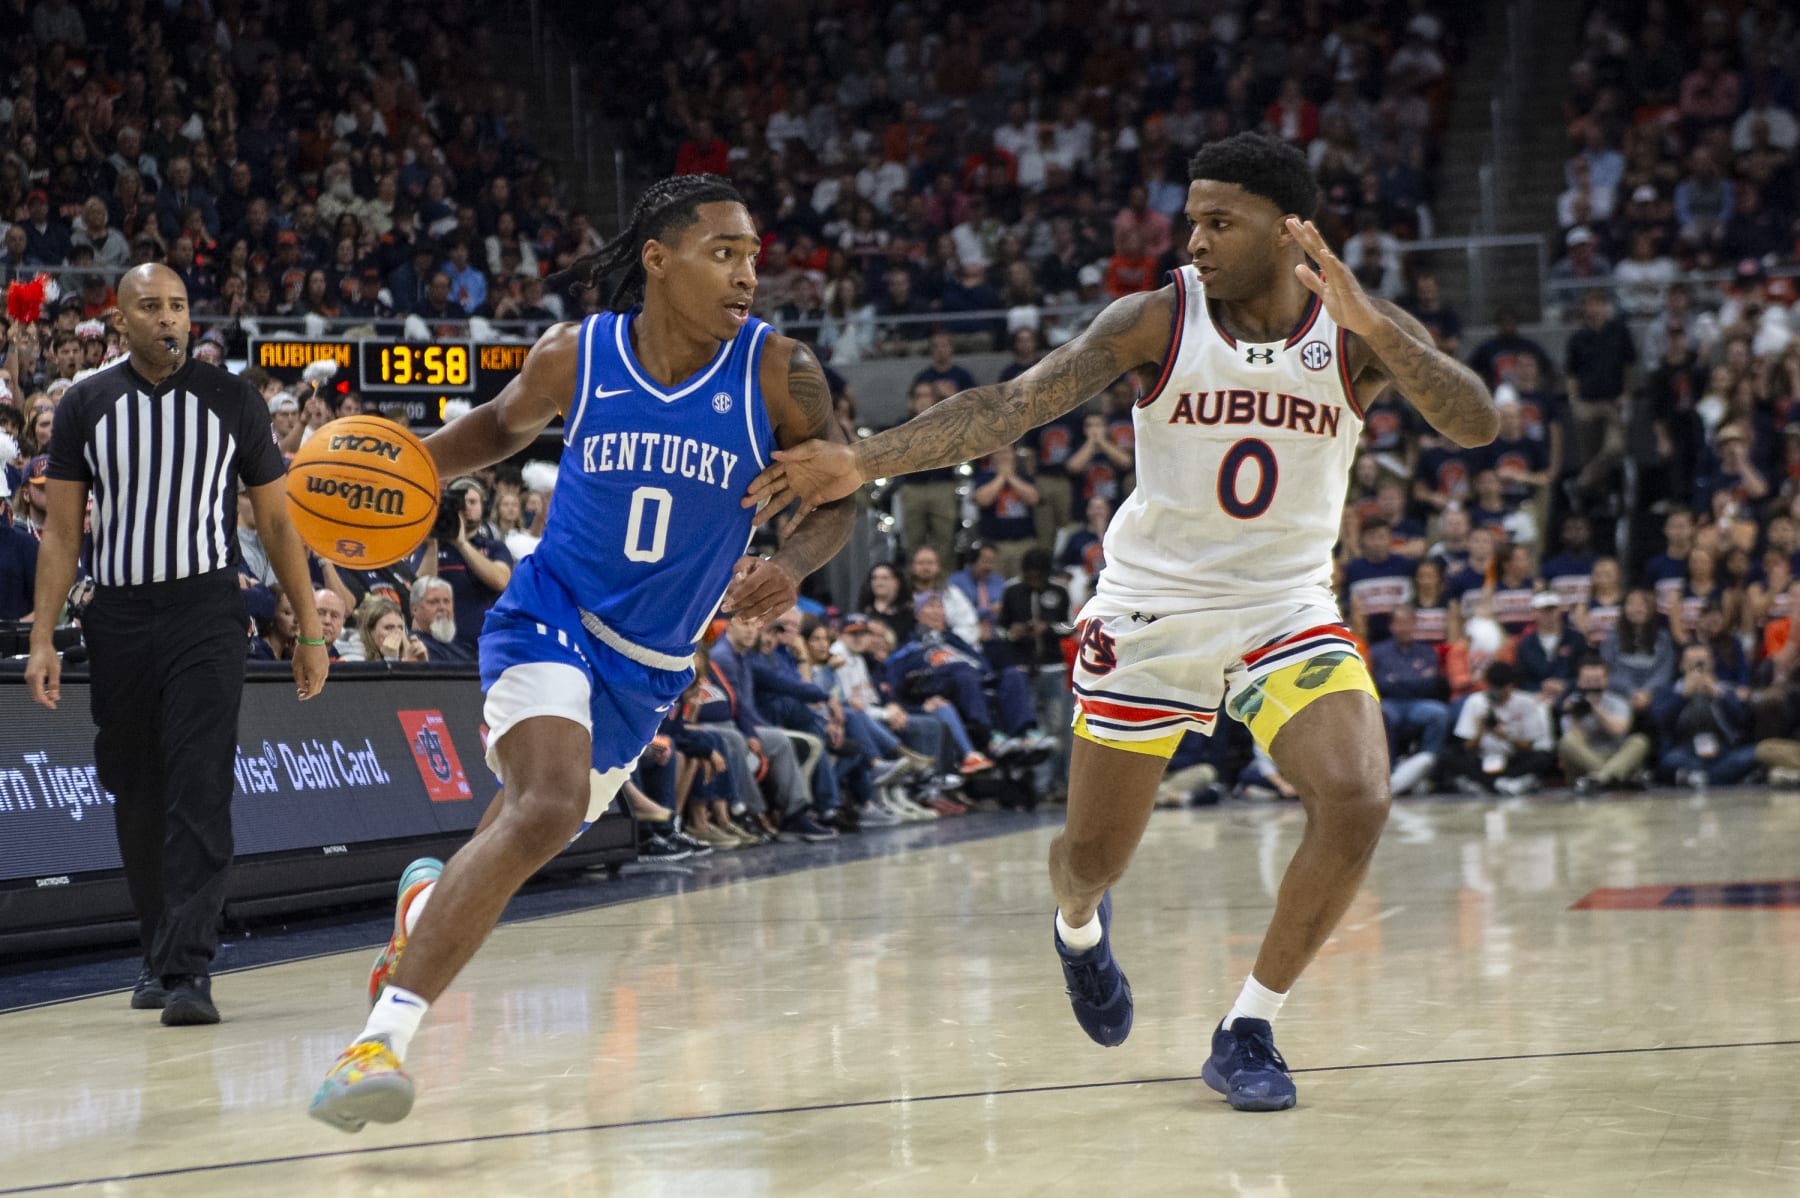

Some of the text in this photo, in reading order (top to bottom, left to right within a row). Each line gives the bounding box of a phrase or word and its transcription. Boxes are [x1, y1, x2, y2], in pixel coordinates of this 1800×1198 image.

[260, 342, 351, 368] AUBURN
[381, 346, 467, 384] 13:58
[1302, 341, 1330, 369] SEC
[713, 393, 731, 411] SEC
[1168, 389, 1341, 437] AUBURN
[328, 434, 402, 463] NCAA
[583, 432, 738, 489] KENTUCKY
[307, 476, 405, 516] Wilson
[1216, 437, 1279, 519] 0
[623, 486, 673, 563] 0
[23, 751, 117, 821] Tiger
[277, 739, 341, 790] Debit
[332, 738, 390, 786] Card.
